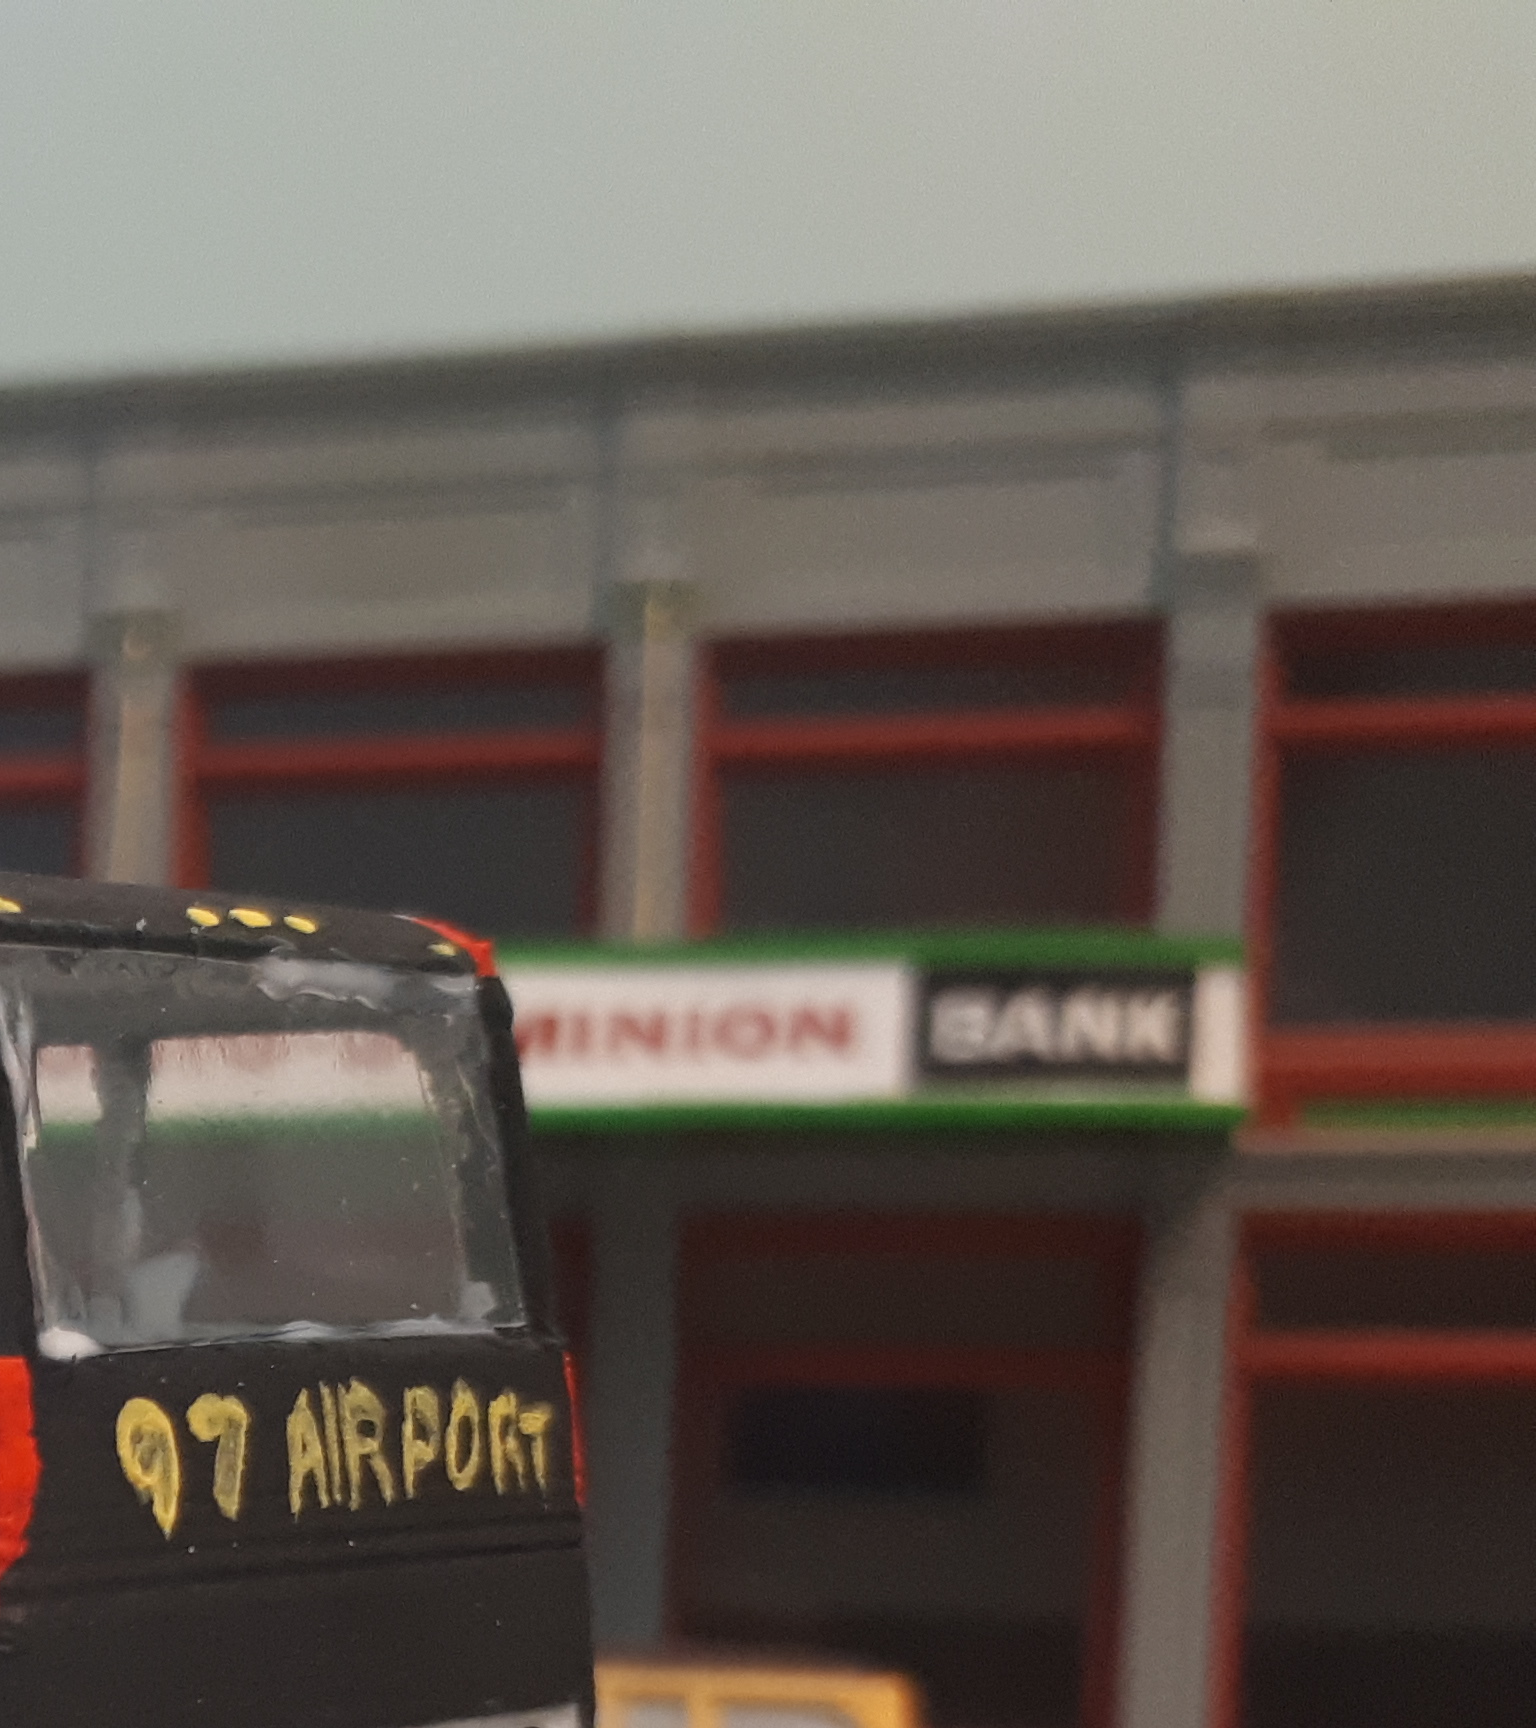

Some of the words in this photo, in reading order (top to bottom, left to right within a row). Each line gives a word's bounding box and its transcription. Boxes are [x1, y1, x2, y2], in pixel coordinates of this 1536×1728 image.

[930, 984, 1180, 1063] BANK
[115, 1394, 251, 1540] 97
[285, 1376, 553, 1523] AIRPORT
